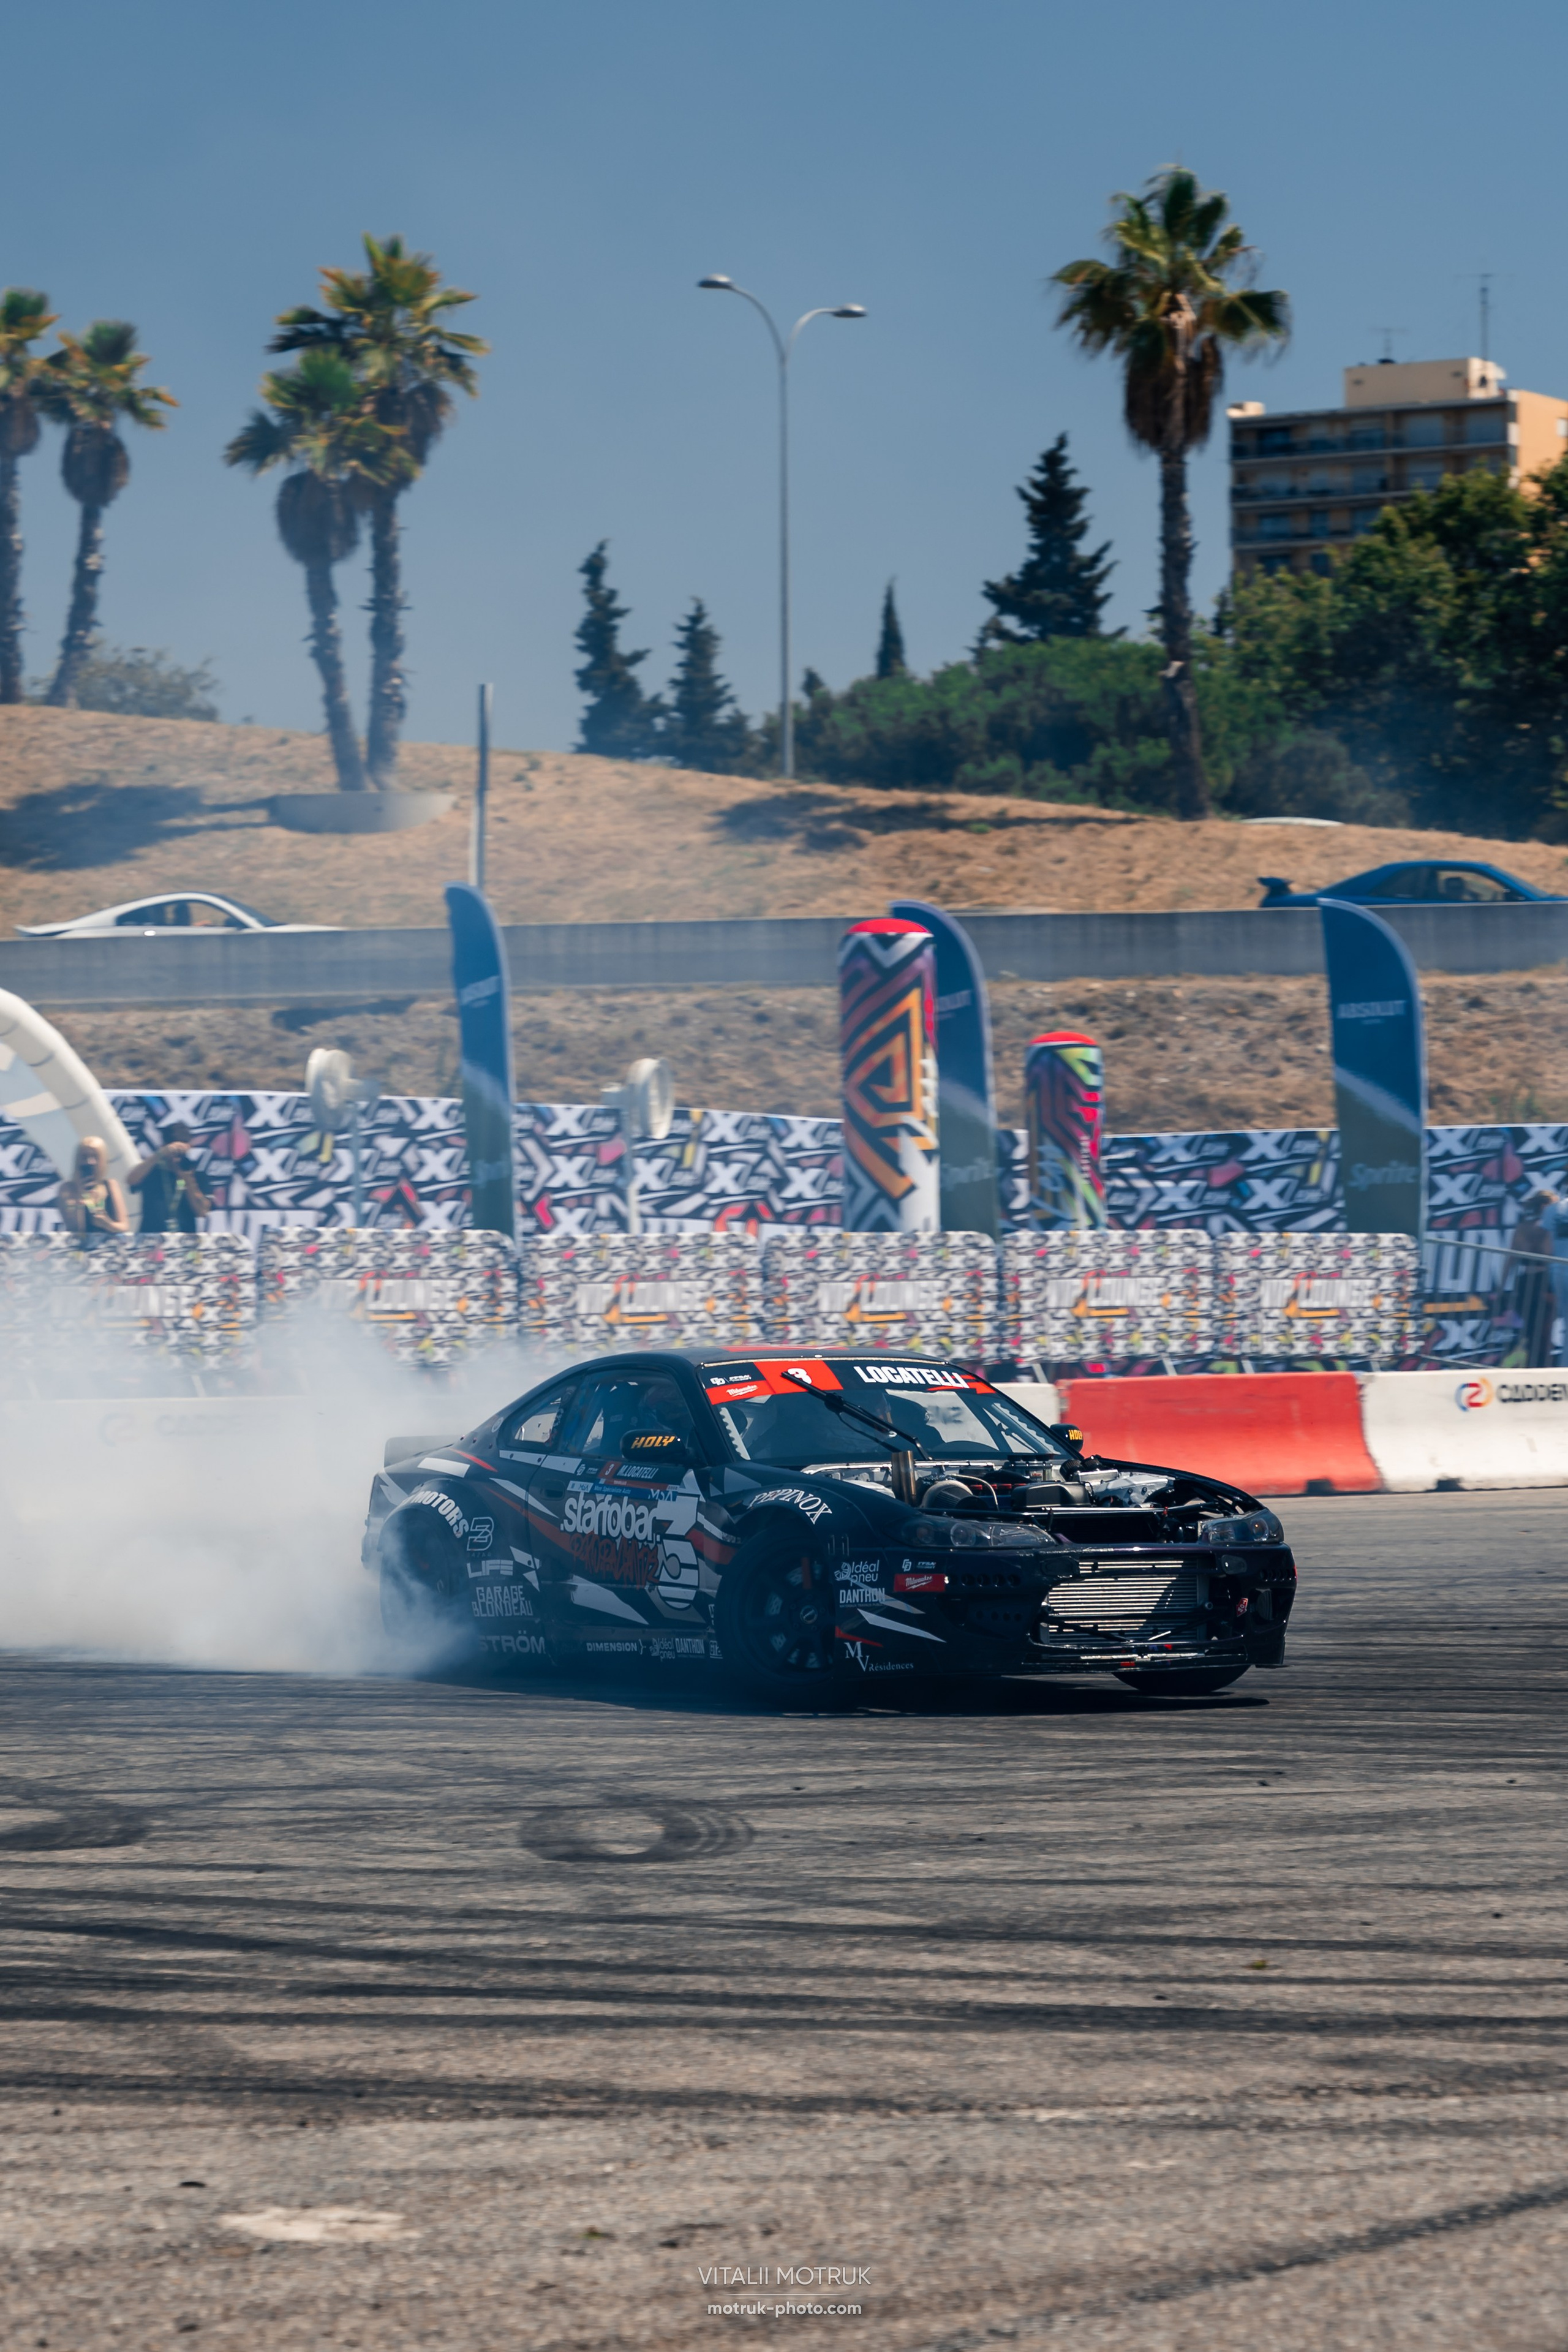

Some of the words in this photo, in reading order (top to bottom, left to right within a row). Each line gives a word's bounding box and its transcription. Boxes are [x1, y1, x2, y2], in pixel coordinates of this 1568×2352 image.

[853, 1366, 970, 1389] LOCATELLI
[631, 1436, 675, 1449] HOLY
[605, 1463, 615, 1476] 3
[746, 1488, 832, 1525] PEPINOX
[851, 1559, 880, 1573] Idéal
[850, 1573, 878, 1586] pneu
[476, 1585, 525, 1602] GARAGE
[839, 1588, 886, 1604] DANTHON
[472, 1600, 533, 1617] BLONDEAU
[586, 1642, 638, 1652] DIMENSION
[675, 1638, 705, 1654] DANTHON
[869, 1662, 914, 1672] Résidences
